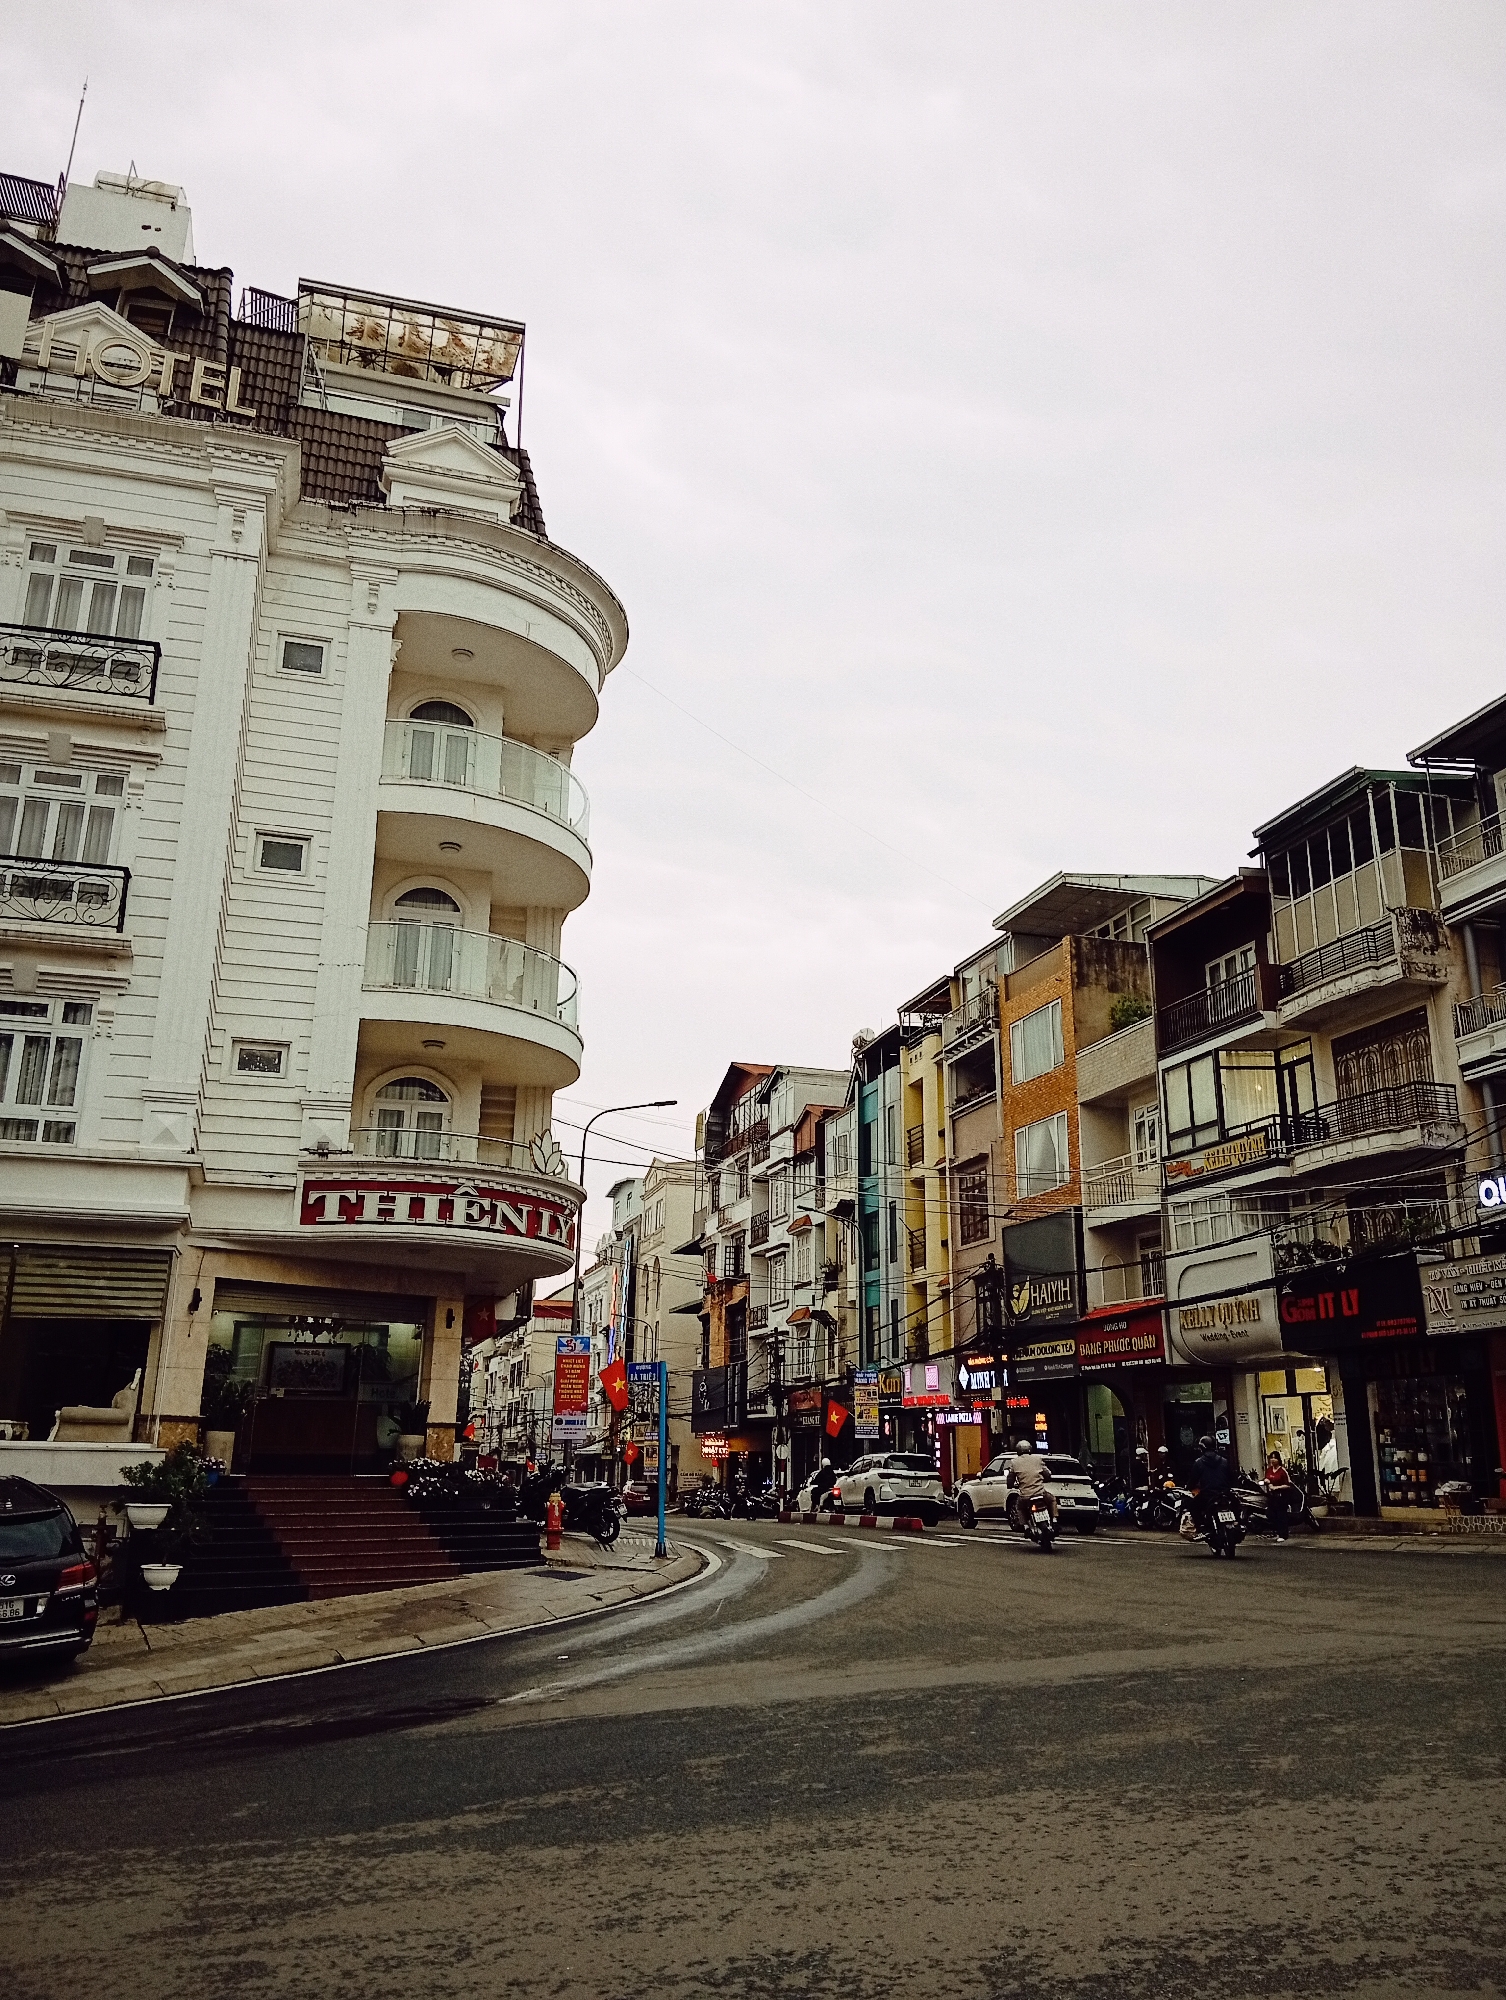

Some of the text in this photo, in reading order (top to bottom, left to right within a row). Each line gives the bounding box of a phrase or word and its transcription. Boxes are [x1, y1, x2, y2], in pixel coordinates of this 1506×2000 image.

[38, 321, 257, 419] HOTEL
[308, 1184, 575, 1246] THIÊN LÝ
[1030, 1277, 1071, 1307] HAIYIH
[1318, 1292, 1335, 1320] IT
[1341, 1288, 1359, 1317] LY
